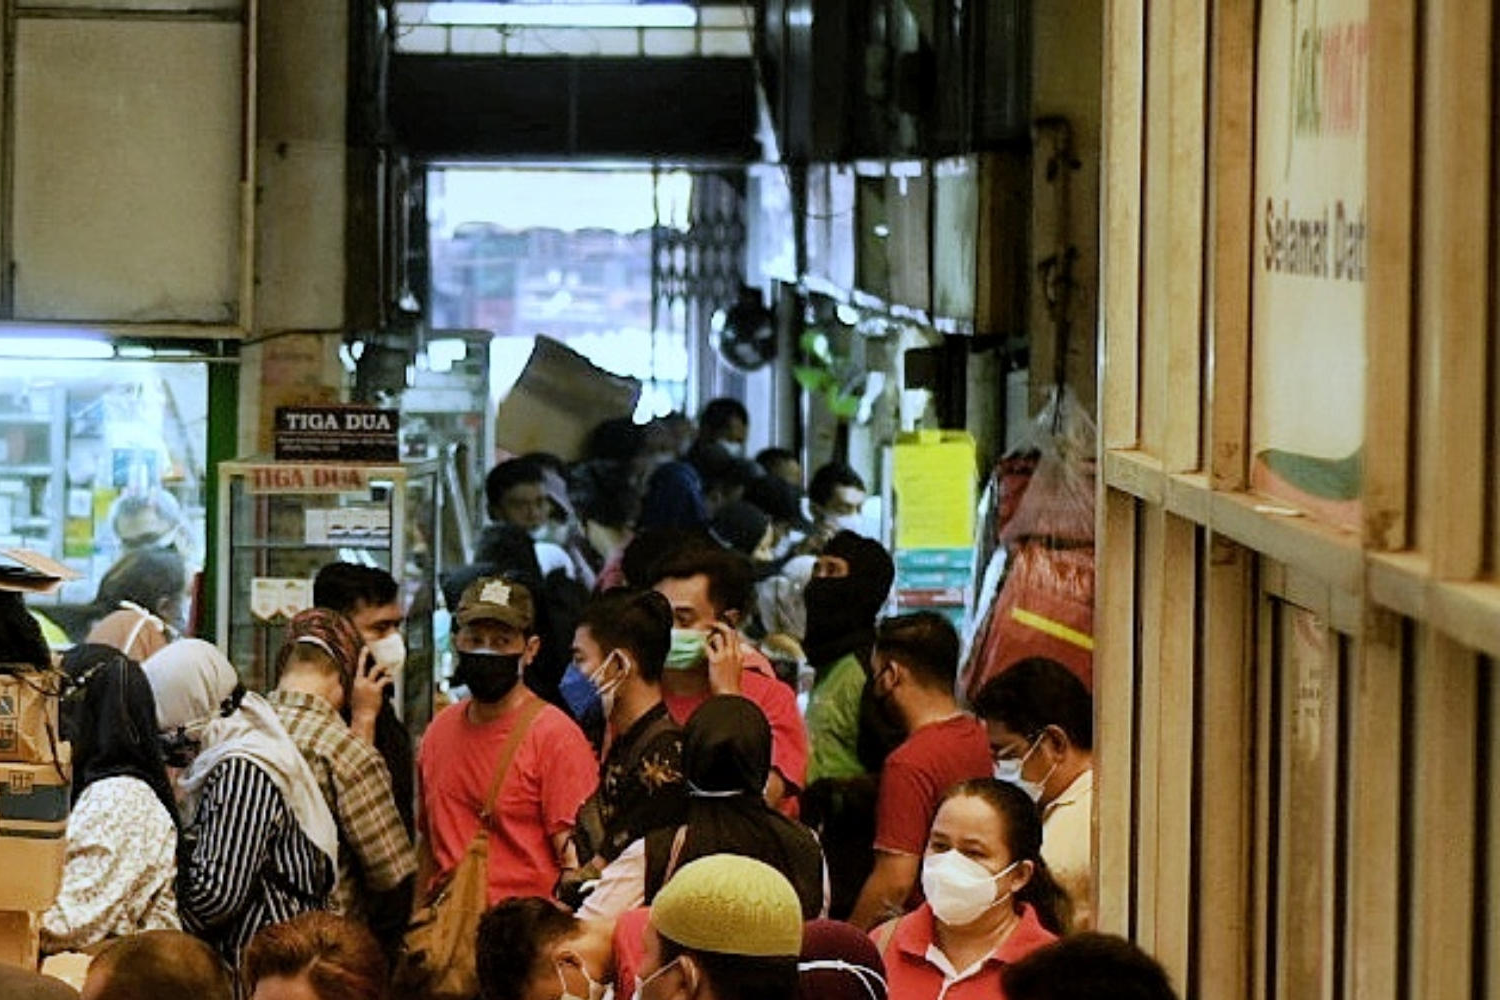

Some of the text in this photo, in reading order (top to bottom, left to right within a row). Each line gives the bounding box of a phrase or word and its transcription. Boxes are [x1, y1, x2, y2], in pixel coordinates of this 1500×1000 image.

[1264, 196, 1328, 278] Selamat
[286, 413, 391, 430] TIGA DUA
[255, 467, 362, 488] TIGA DUA
